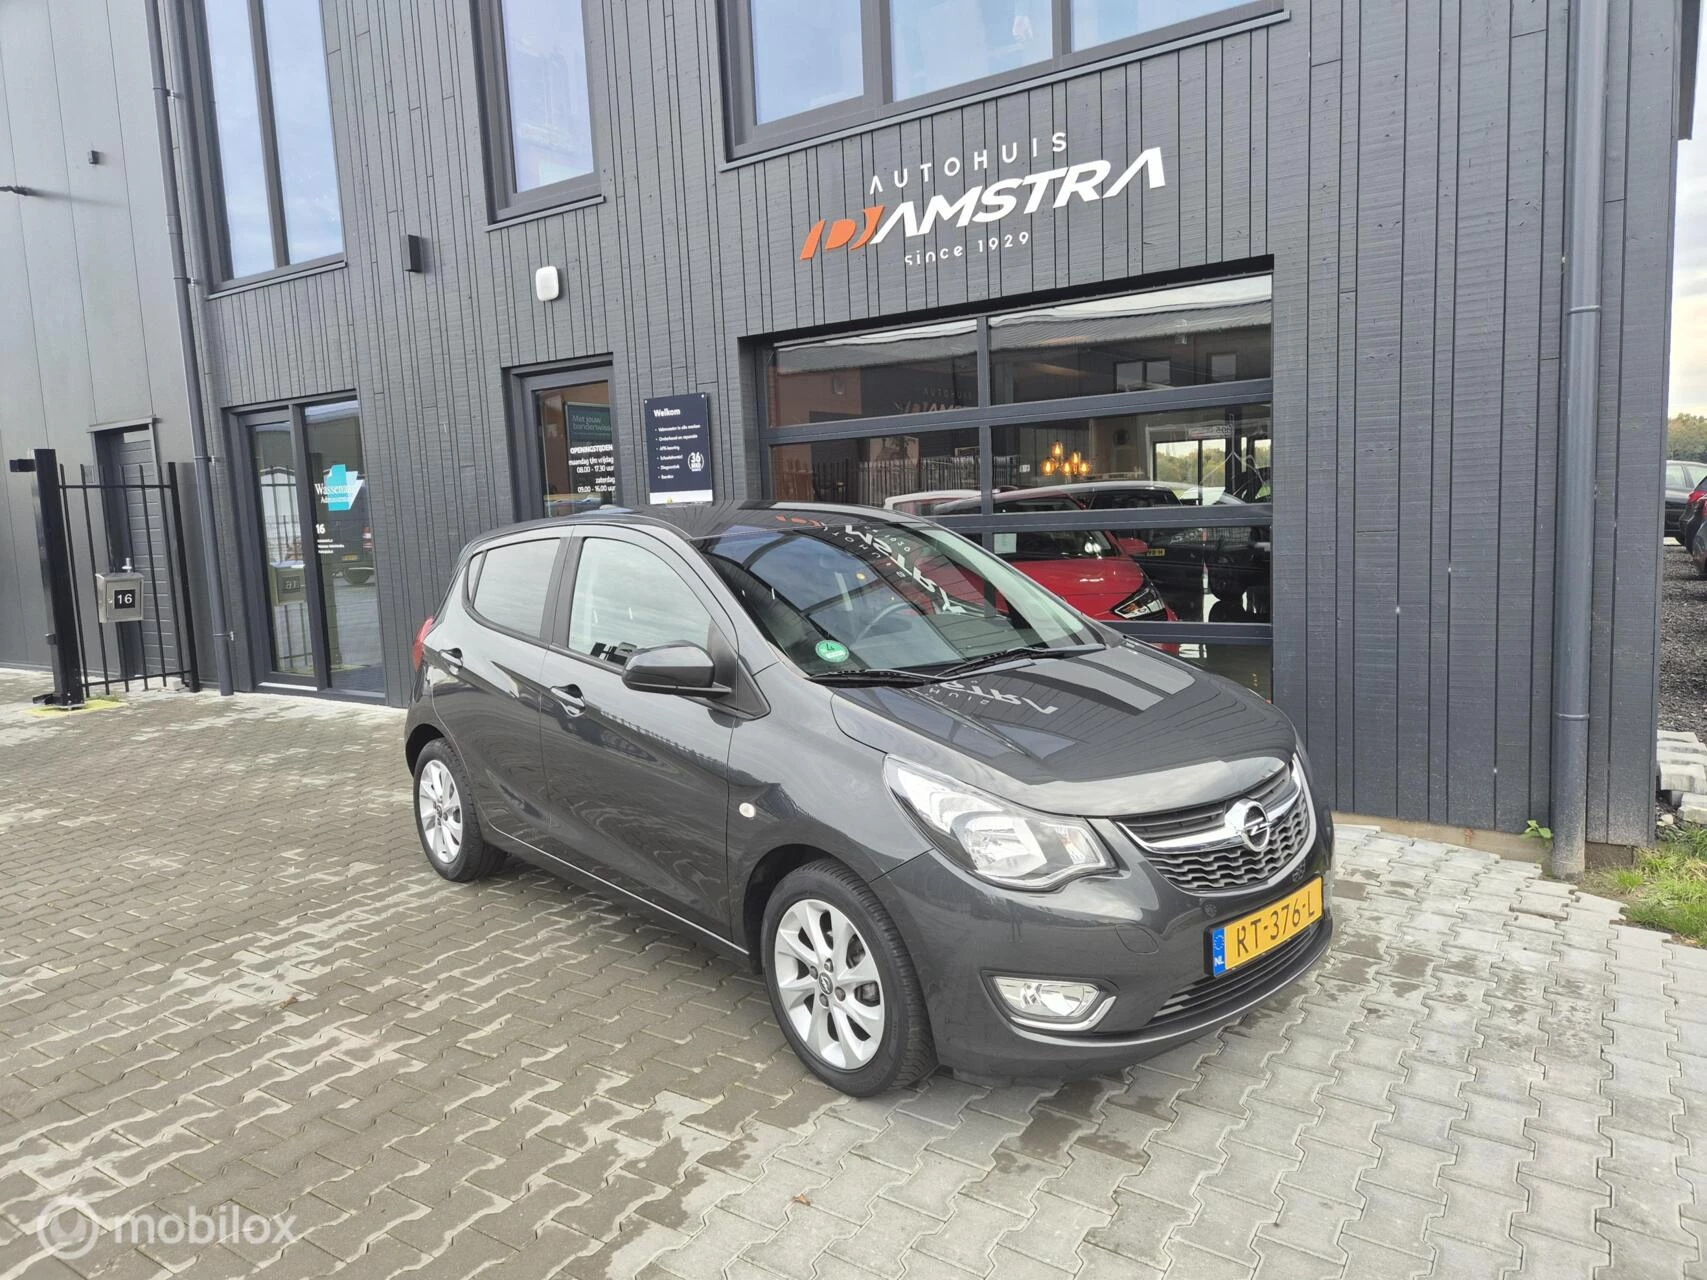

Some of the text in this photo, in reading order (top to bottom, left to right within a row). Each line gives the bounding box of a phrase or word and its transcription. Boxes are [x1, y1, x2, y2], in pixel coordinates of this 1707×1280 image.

[869, 132, 1067, 195] AUTOHUIS
[904, 231, 1030, 267] since 1929
[653, 408, 681, 417] Welkom
[570, 445, 613, 454] OPENINGSTIJDEN
[569, 458, 589, 466] maandag
[598, 456, 614, 464] vrijdag
[690, 452, 701, 463] 36
[595, 476, 616, 484] zaterdag
[315, 523, 326, 534] 16
[117, 593, 133, 605] 16
[1236, 891, 1315, 958] RT-376-L
[1214, 955, 1225, 967] NL
